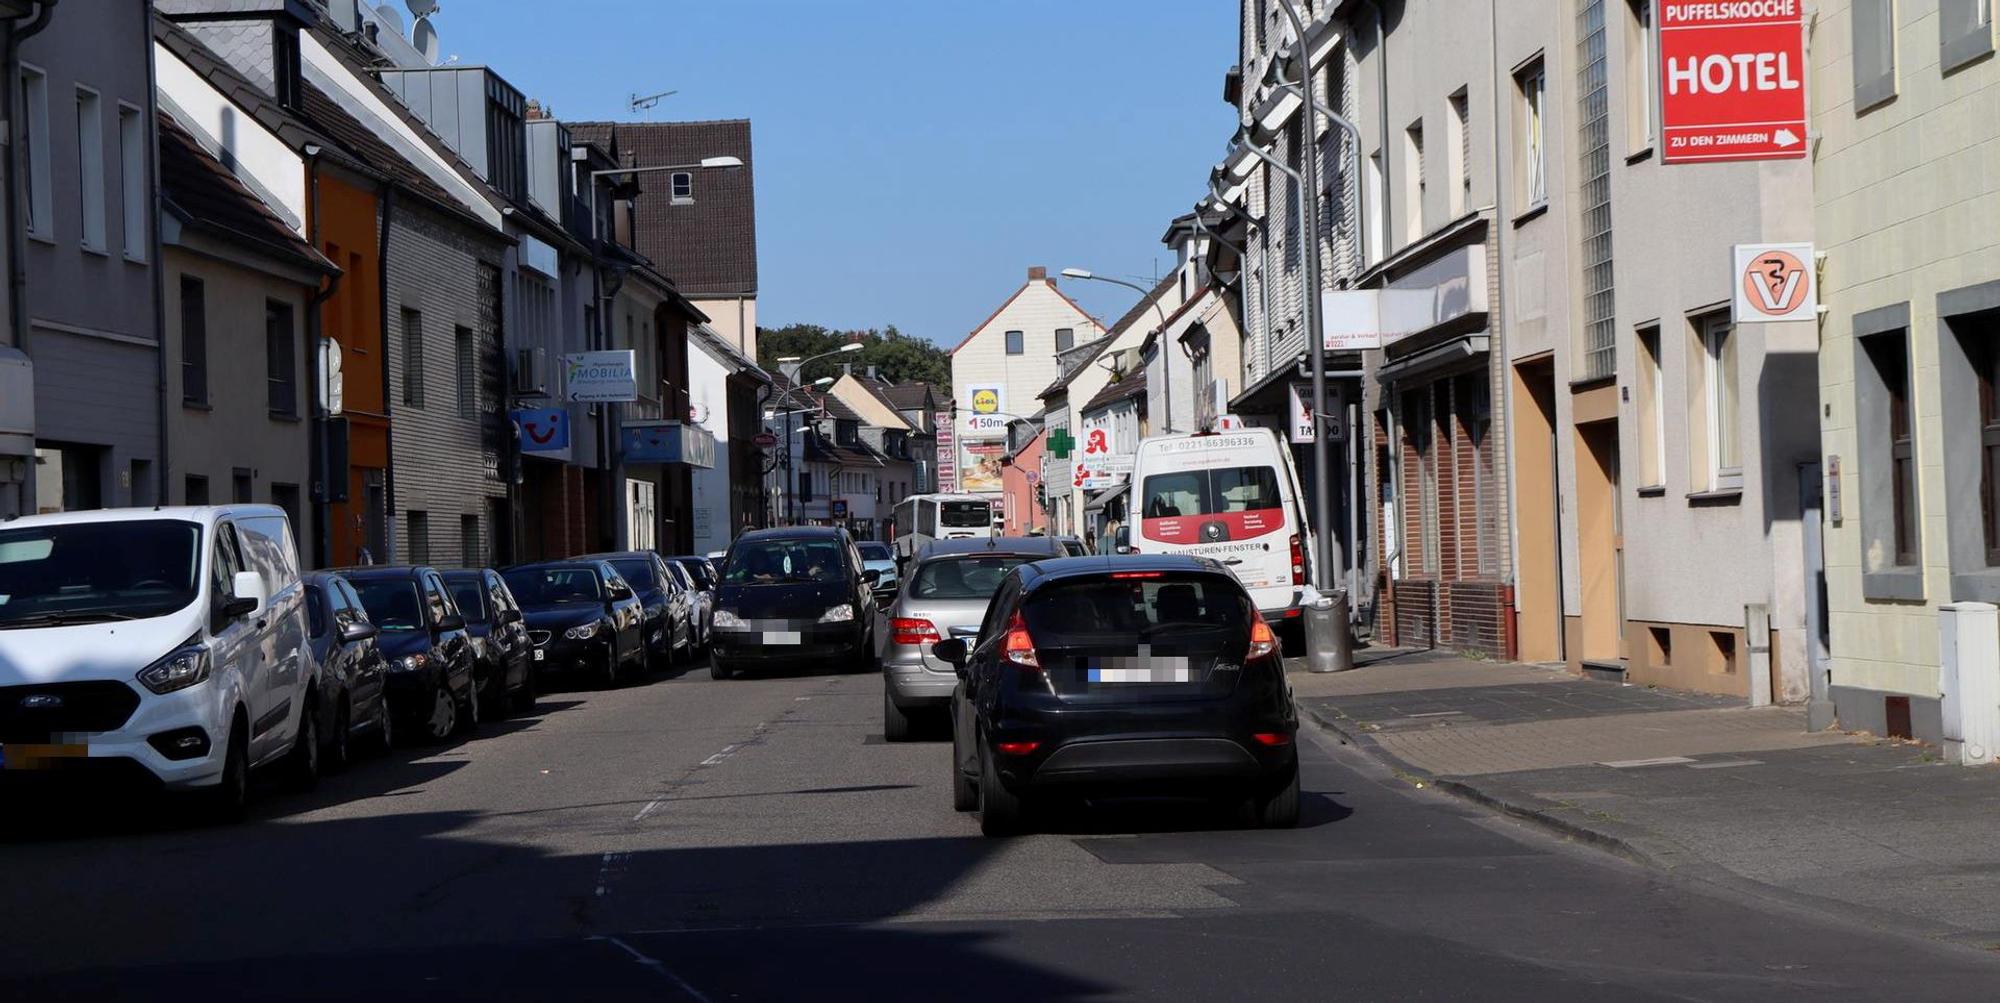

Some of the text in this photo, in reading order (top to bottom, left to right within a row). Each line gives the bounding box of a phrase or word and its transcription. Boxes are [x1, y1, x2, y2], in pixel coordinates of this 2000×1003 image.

[1666, 0, 1795, 22] PUFFELSKOOCHE
[1667, 51, 1800, 96] HOTEL
[1671, 133, 1769, 147] ZU DEN ZIMMERN
